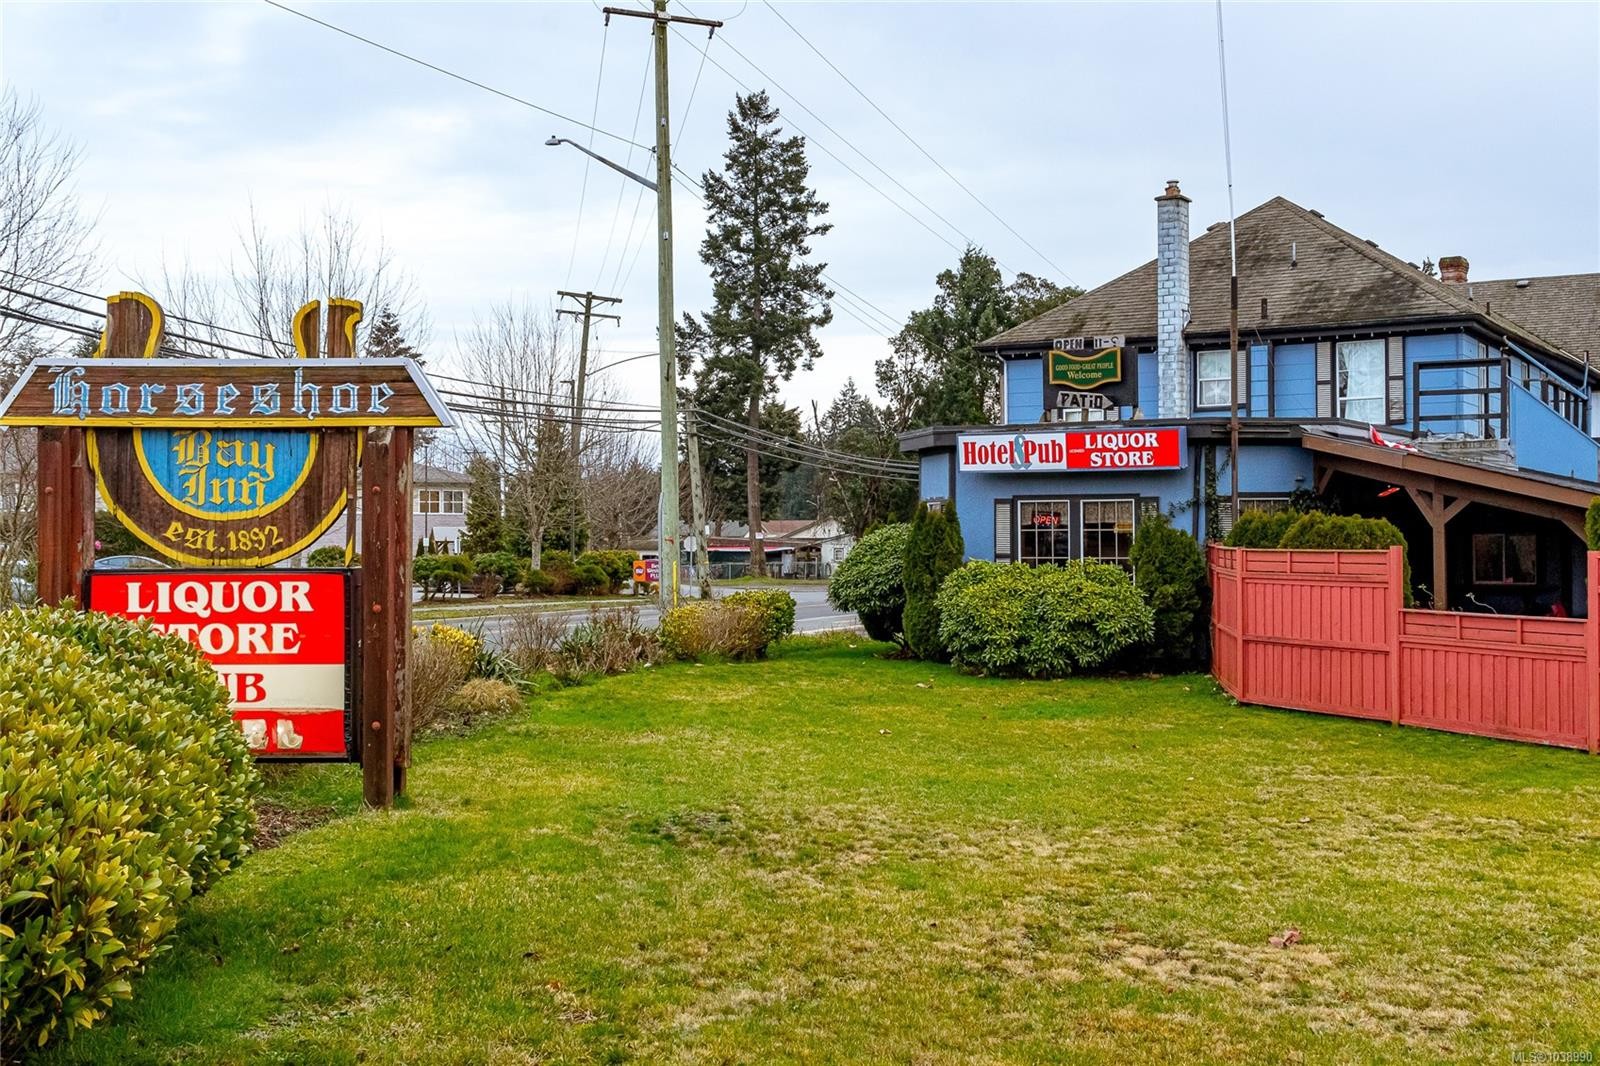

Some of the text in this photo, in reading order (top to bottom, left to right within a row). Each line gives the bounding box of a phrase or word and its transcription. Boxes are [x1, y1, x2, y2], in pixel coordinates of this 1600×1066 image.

[1055, 339, 1082, 349] OPEN
[1067, 371, 1103, 379] Welcome
[48, 367, 396, 420] Horseshoe
[1084, 432, 1159, 450] LIQUOR
[172, 430, 276, 482] Bay
[1090, 451, 1155, 467] STORE
[178, 466, 266, 507] Inn
[1033, 515, 1059, 525] OPEN
[125, 580, 314, 618] LIQUOR
